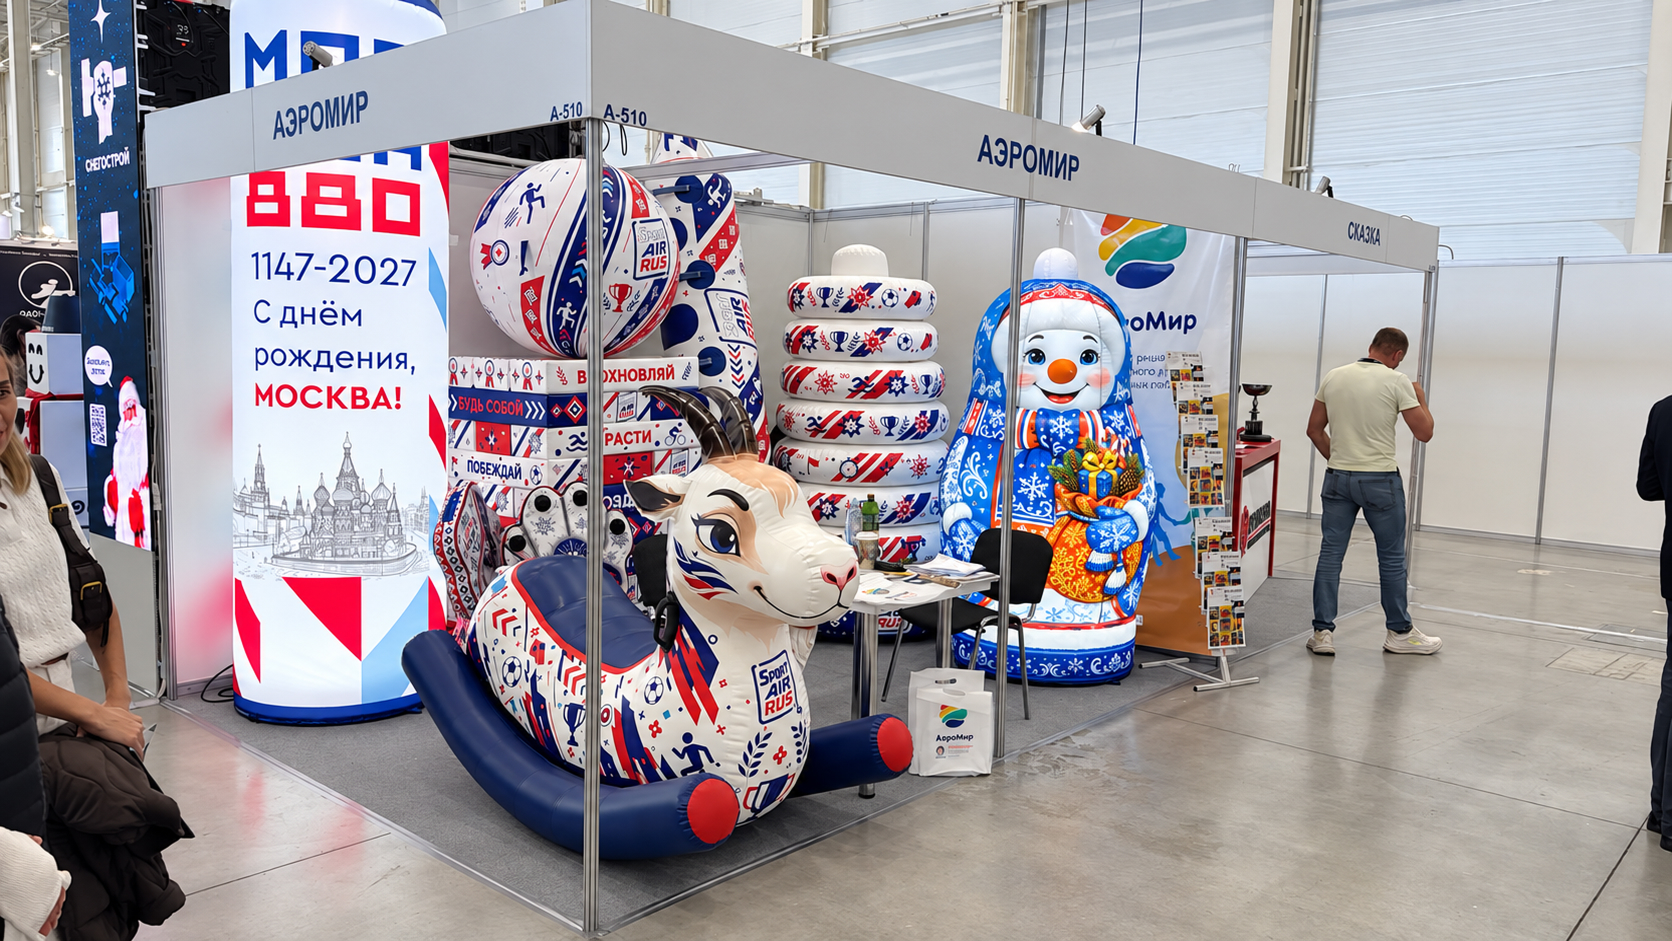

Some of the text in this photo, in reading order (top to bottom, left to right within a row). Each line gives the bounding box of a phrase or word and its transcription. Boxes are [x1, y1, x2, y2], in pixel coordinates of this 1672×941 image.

[273, 90, 369, 140] АЭРОМИР
[550, 101, 583, 121] А-510
[603, 103, 647, 126] А-510
[85, 146, 130, 172] СНЕГОСТРОЙ
[977, 134, 1080, 181] АЭРОМИР
[1348, 221, 1381, 246] СКАЗКА
[641, 240, 666, 258] AIR
[251, 251, 417, 287] 1147-2027
[640, 255, 667, 272] RUS
[254, 299, 362, 329] С днём
[1126, 311, 1197, 334] оМир
[255, 347, 416, 376] рождения,
[577, 363, 675, 384] ВОХНОВЛЯЙ
[255, 382, 402, 410] МОСКВА!
[458, 395, 523, 417] БУДЬ СОБОЙ
[604, 429, 652, 446] РАСТИ
[467, 459, 522, 480] ПОБЕЖДАЙ
[759, 661, 788, 687] SPORT
[765, 674, 791, 700] AIR
[765, 690, 793, 716] RUS
